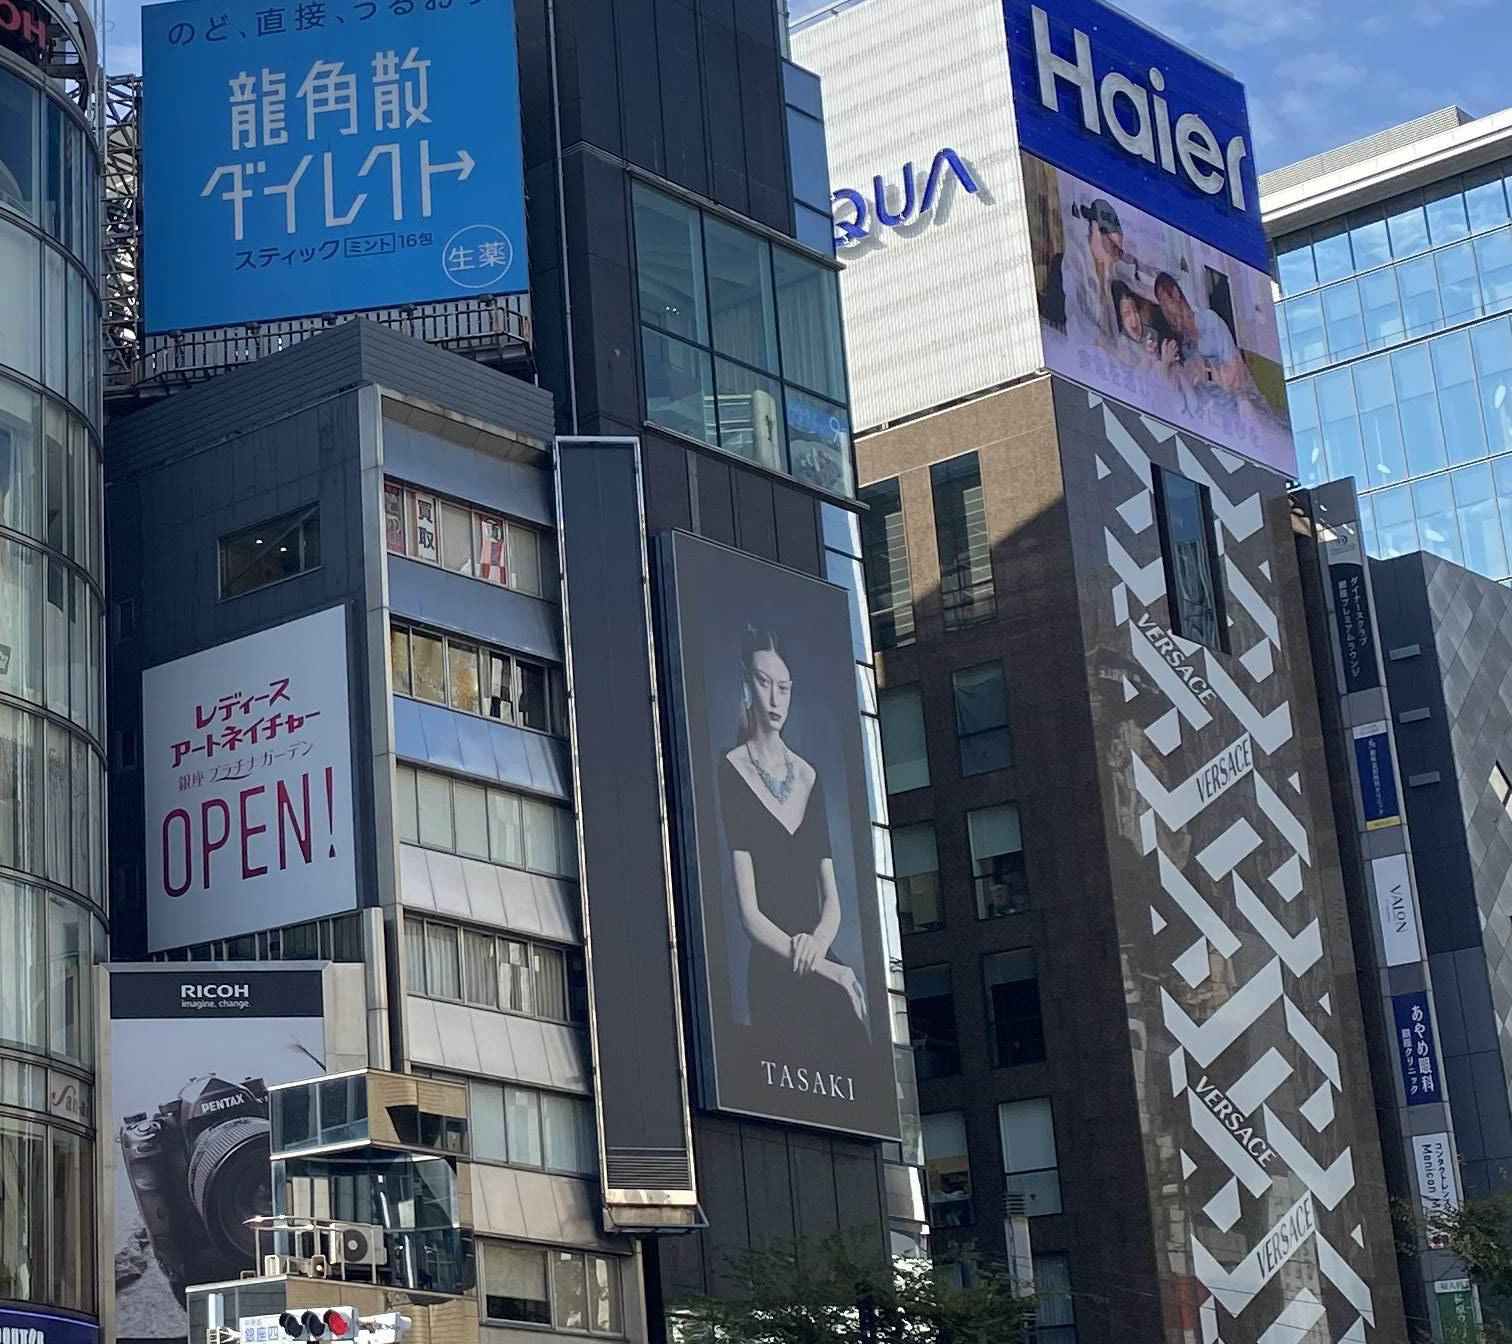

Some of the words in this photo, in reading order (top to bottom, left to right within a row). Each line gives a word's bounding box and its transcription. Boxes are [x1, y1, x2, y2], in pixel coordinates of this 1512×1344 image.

[228, 46, 433, 152] 龍角散
[1030, 4, 1252, 212] Haier
[200, 139, 476, 241] ダイレクト
[234, 239, 340, 272] スティック
[347, 236, 393, 255] ミント
[398, 231, 434, 250] 16包
[447, 240, 508, 273] 生薬
[1136, 612, 1216, 706] VERSACE
[194, 677, 291, 730] レディース
[170, 709, 321, 768] アートネイチャー
[1195, 739, 1253, 805] VERSACE
[162, 765, 336, 899] OPEN!
[180, 984, 249, 998] RICOH
[180, 999, 217, 1010] imagine.
[218, 999, 252, 1010] change.
[1410, 1004, 1434, 1093] あやめ眼科
[200, 1093, 245, 1114] PENTAX
[759, 1059, 856, 1103] TASAKI
[1195, 1075, 1279, 1169] VERSACE
[1422, 1143, 1437, 1194] Menicon
[1256, 1199, 1315, 1281] VERSACE
